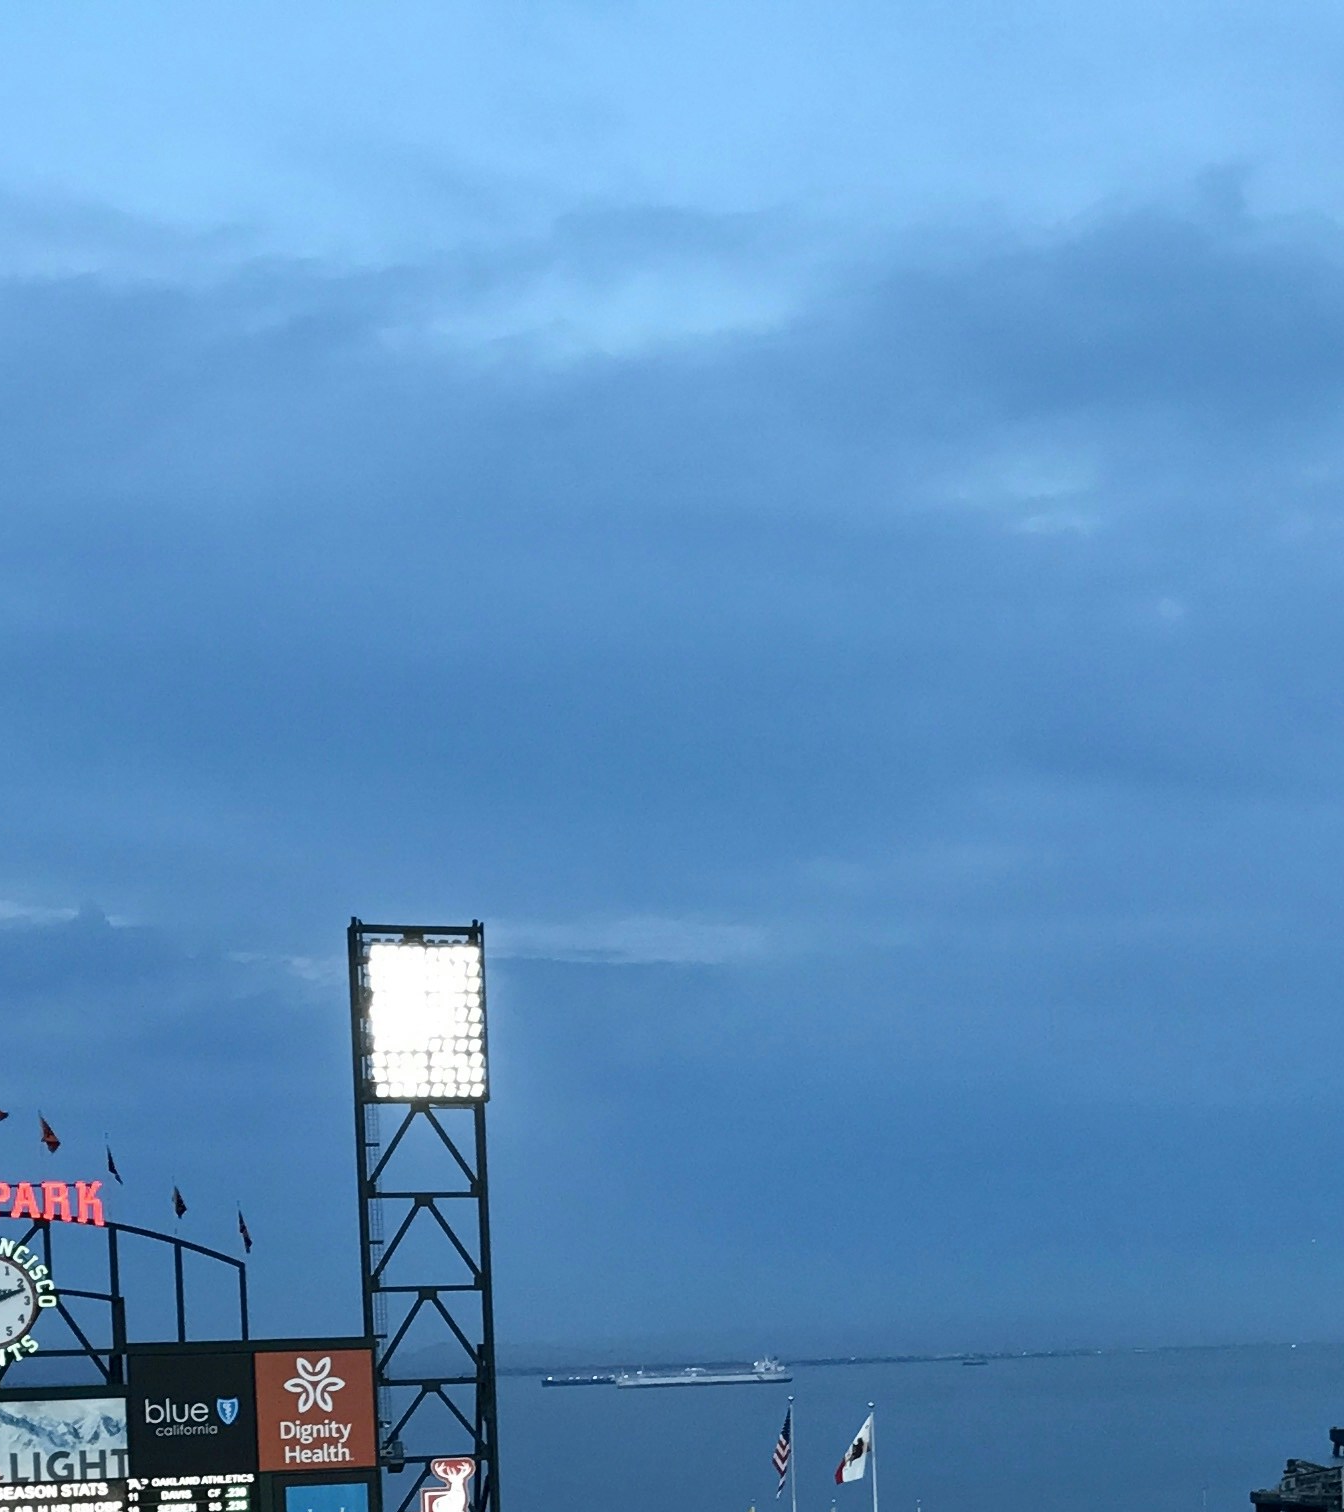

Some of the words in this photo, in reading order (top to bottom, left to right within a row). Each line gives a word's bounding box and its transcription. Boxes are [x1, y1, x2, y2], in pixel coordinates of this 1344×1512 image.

[4, 1265, 10, 1276] 1
[16, 1278, 25, 1289] 2
[24, 1295, 31, 1306] 3
[17, 1314, 25, 1324] 4
[5, 1326, 13, 1337] 5
[144, 1397, 210, 1425] blue
[155, 1422, 219, 1437] california
[279, 1419, 352, 1443] Dignity
[284, 1443, 351, 1465] Health
[9, 1448, 129, 1484] LIGHT
[151, 1477, 201, 1487] OAKLAND
[201, 1474, 255, 1485] ATHLETICS
[60, 1482, 109, 1498] STATS
[128, 1492, 139, 1501] 11
[160, 1490, 192, 1501] DAVIS
[94, 1501, 123, 1512] OBP
